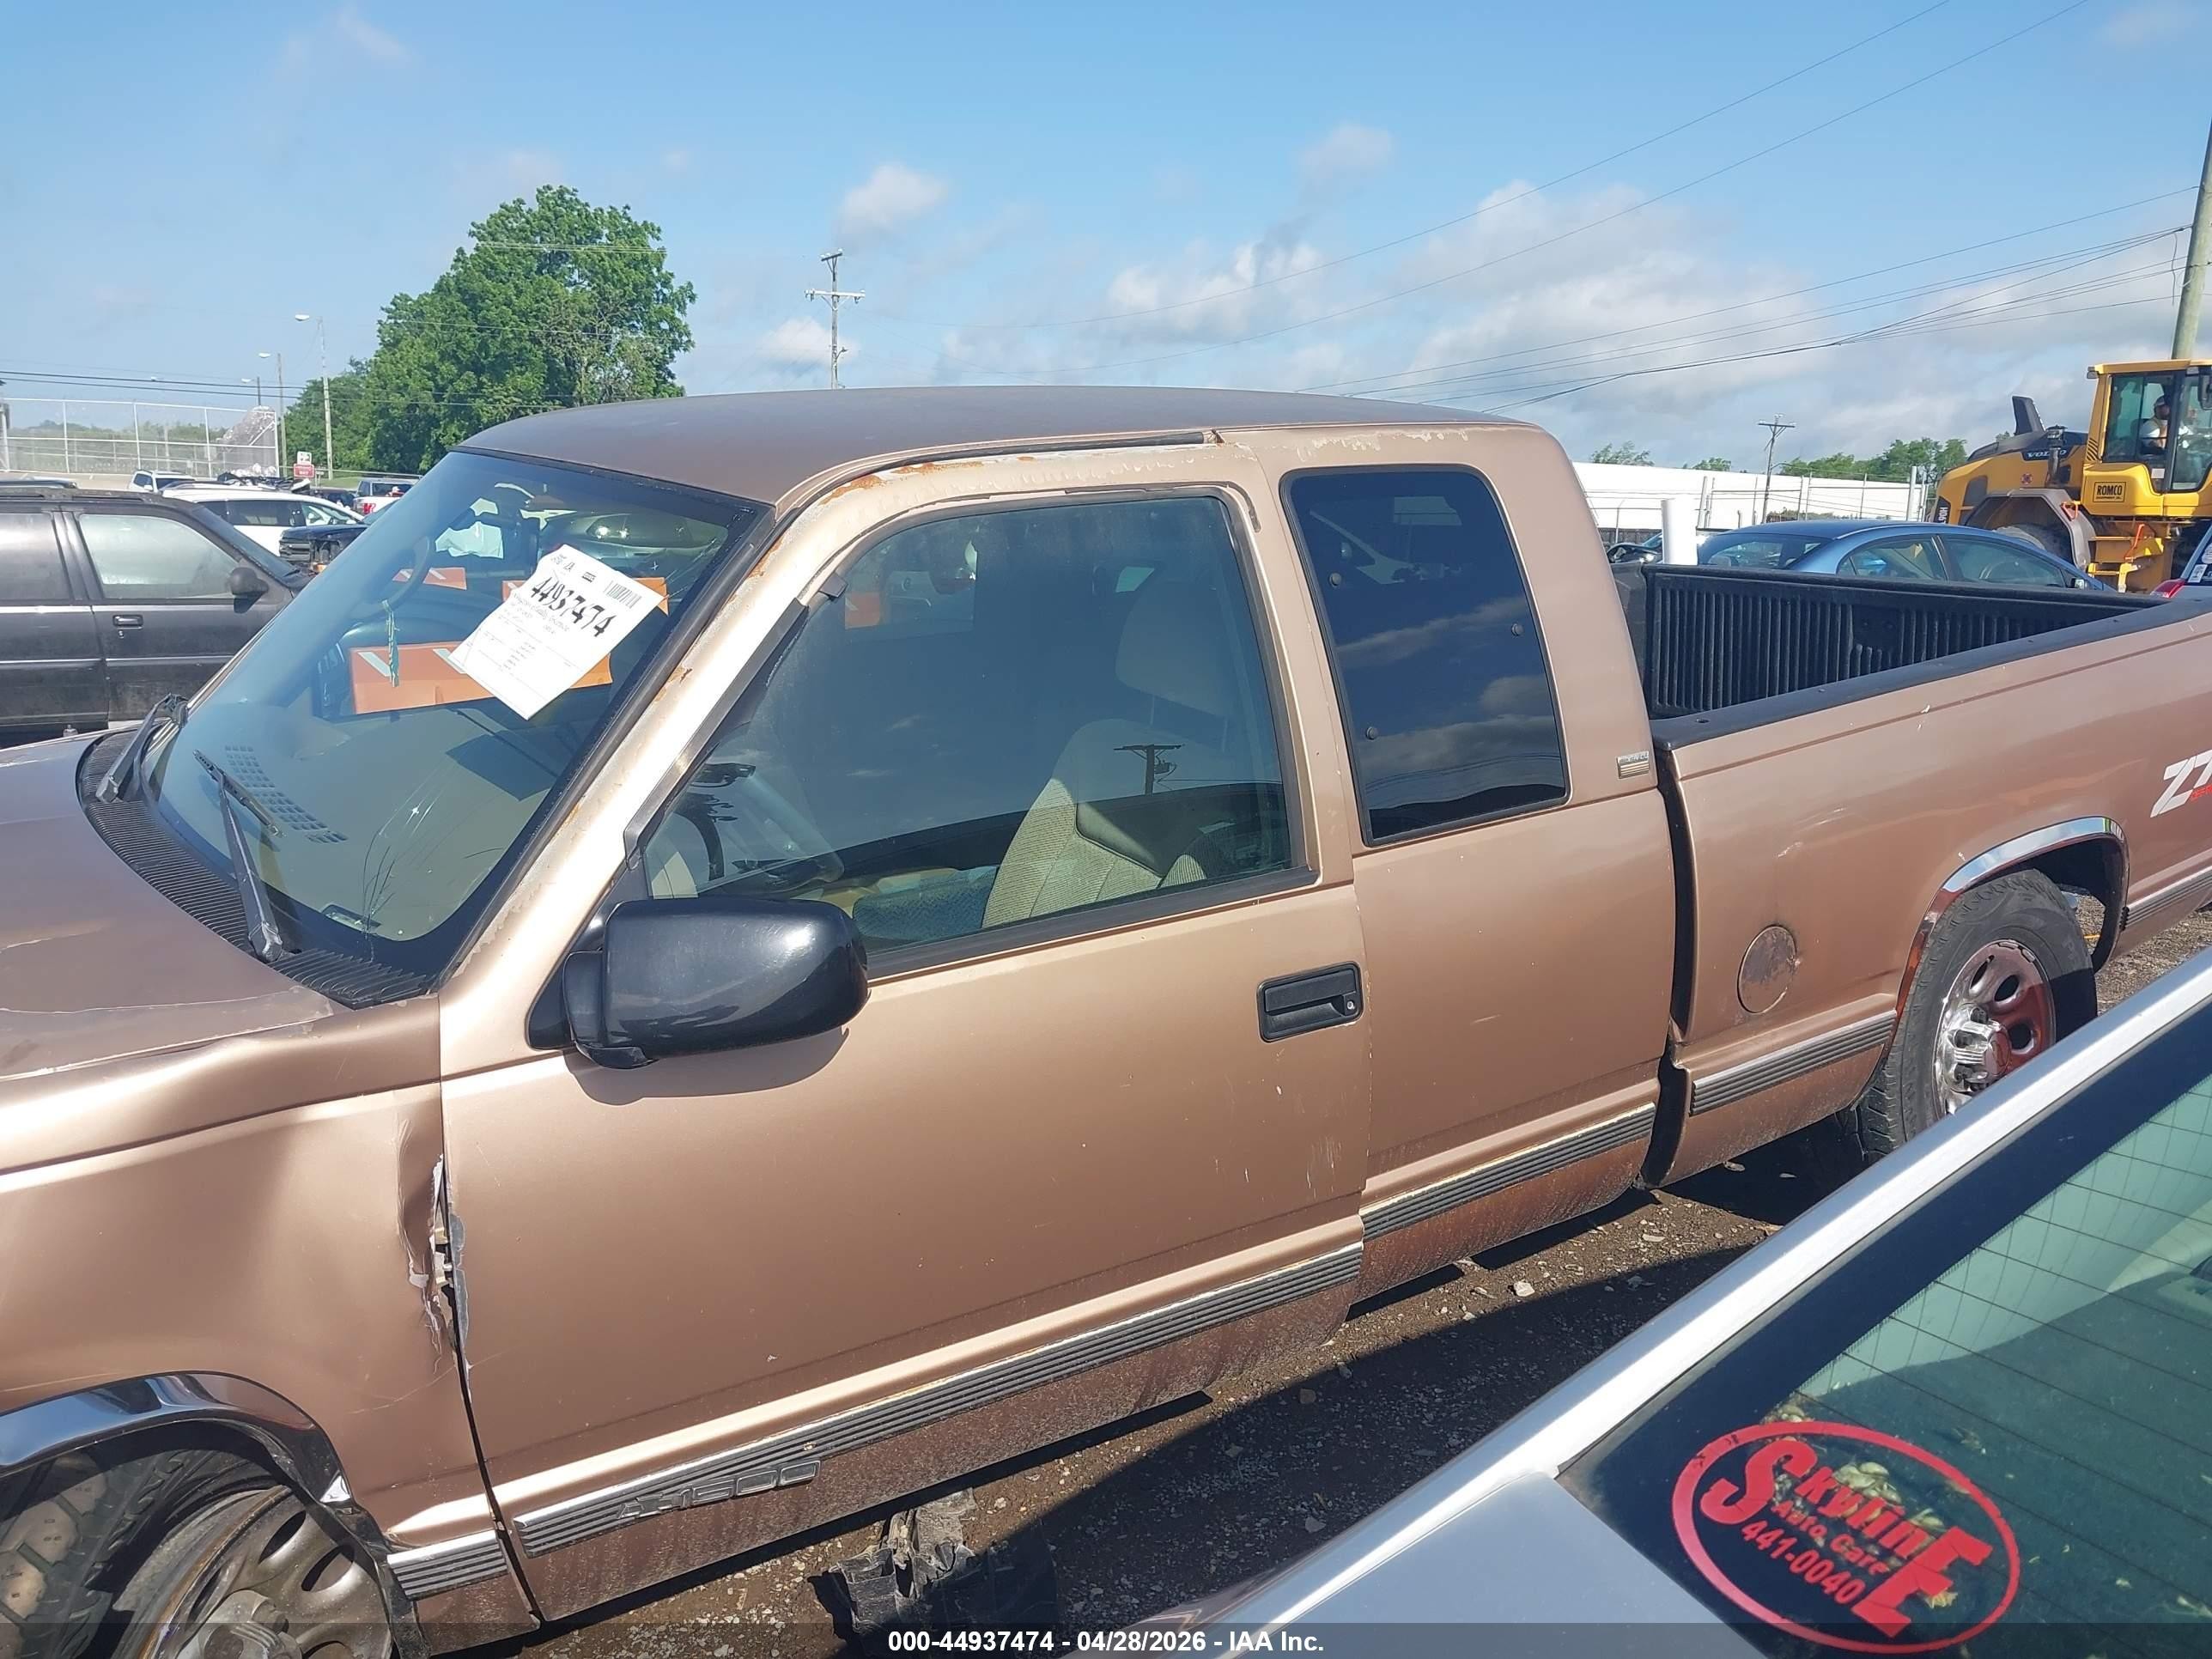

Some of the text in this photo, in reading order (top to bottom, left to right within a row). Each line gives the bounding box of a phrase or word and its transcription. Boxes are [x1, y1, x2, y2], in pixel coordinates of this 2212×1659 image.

[2027, 449, 2067, 458] VOLO
[2097, 484, 2123, 495] ROMCO
[531, 576, 617, 637] 44937474
[1741, 1520, 1866, 1605] 441-0040
[1771, 1499, 1890, 1576] Auto Care
